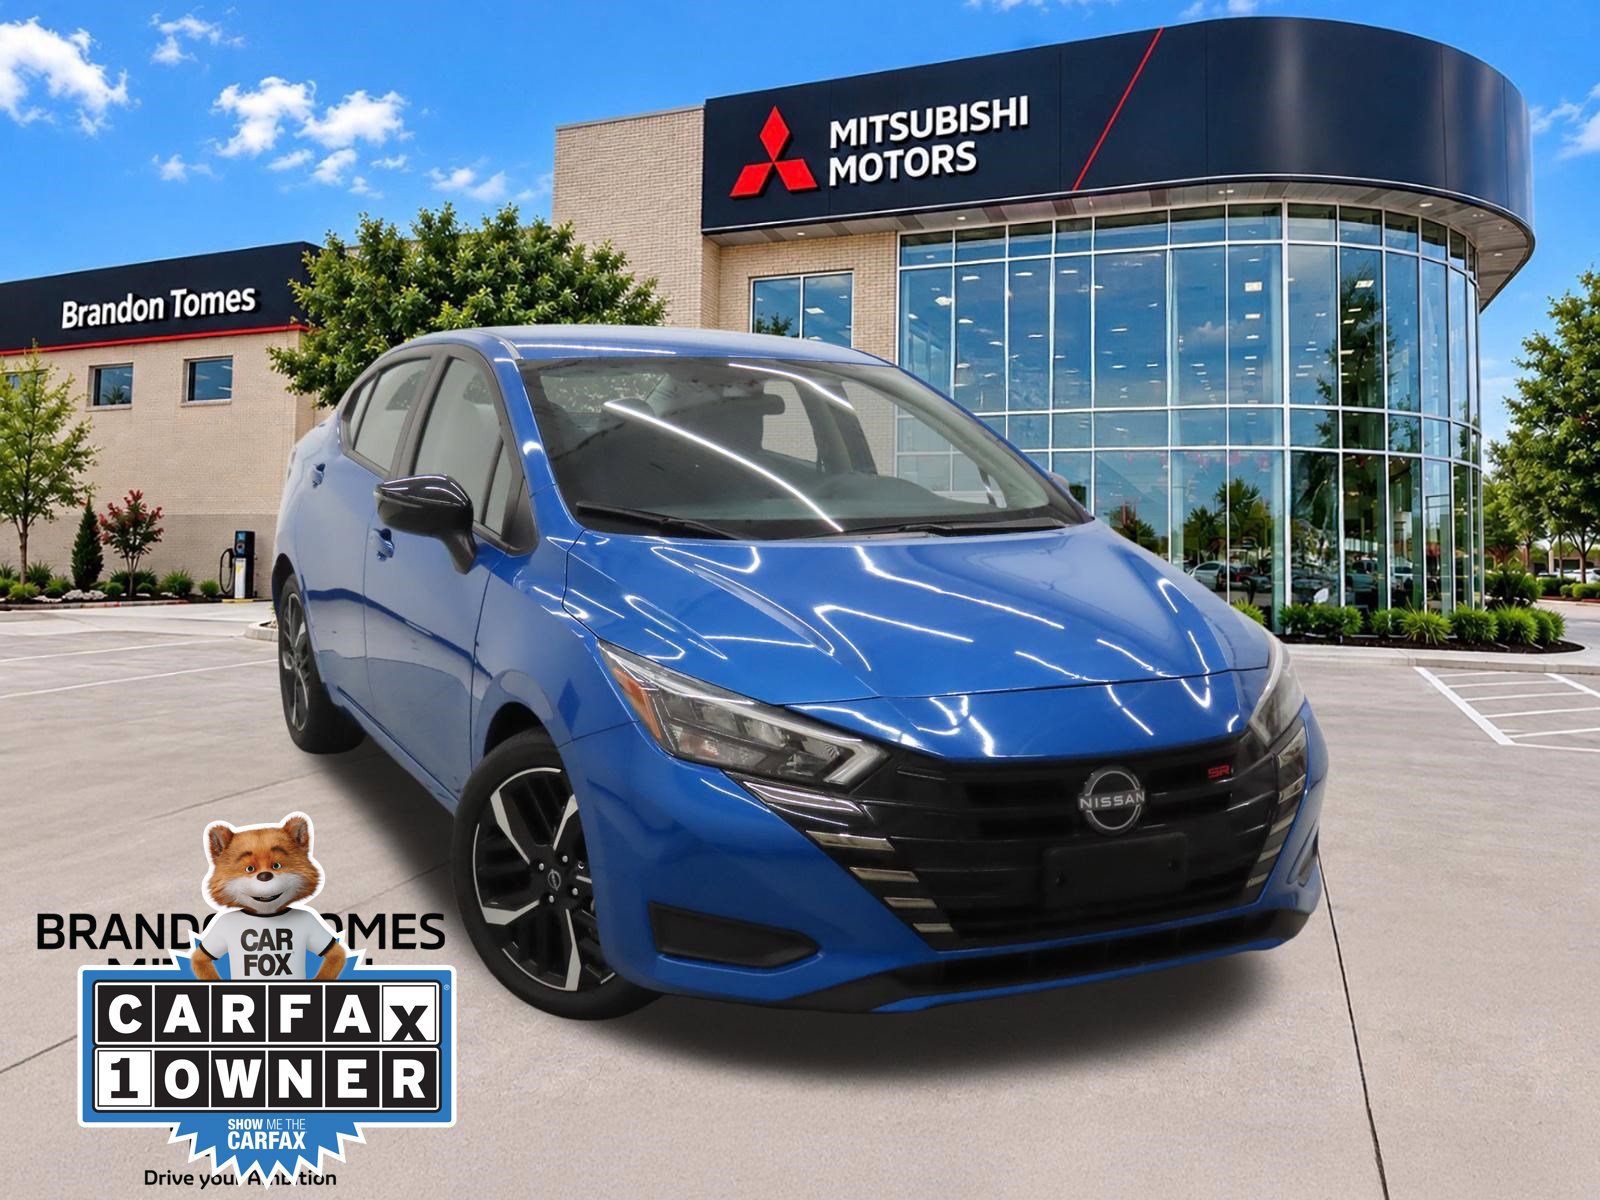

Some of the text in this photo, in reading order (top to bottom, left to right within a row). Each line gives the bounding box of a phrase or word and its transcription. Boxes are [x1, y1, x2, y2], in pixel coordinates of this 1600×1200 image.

[829, 95, 1029, 149] MITSUBISHI
[828, 140, 977, 187] MOTORS
[61, 287, 256, 330] Brandon Tomes
[1079, 791, 1145, 809] NISSAN
